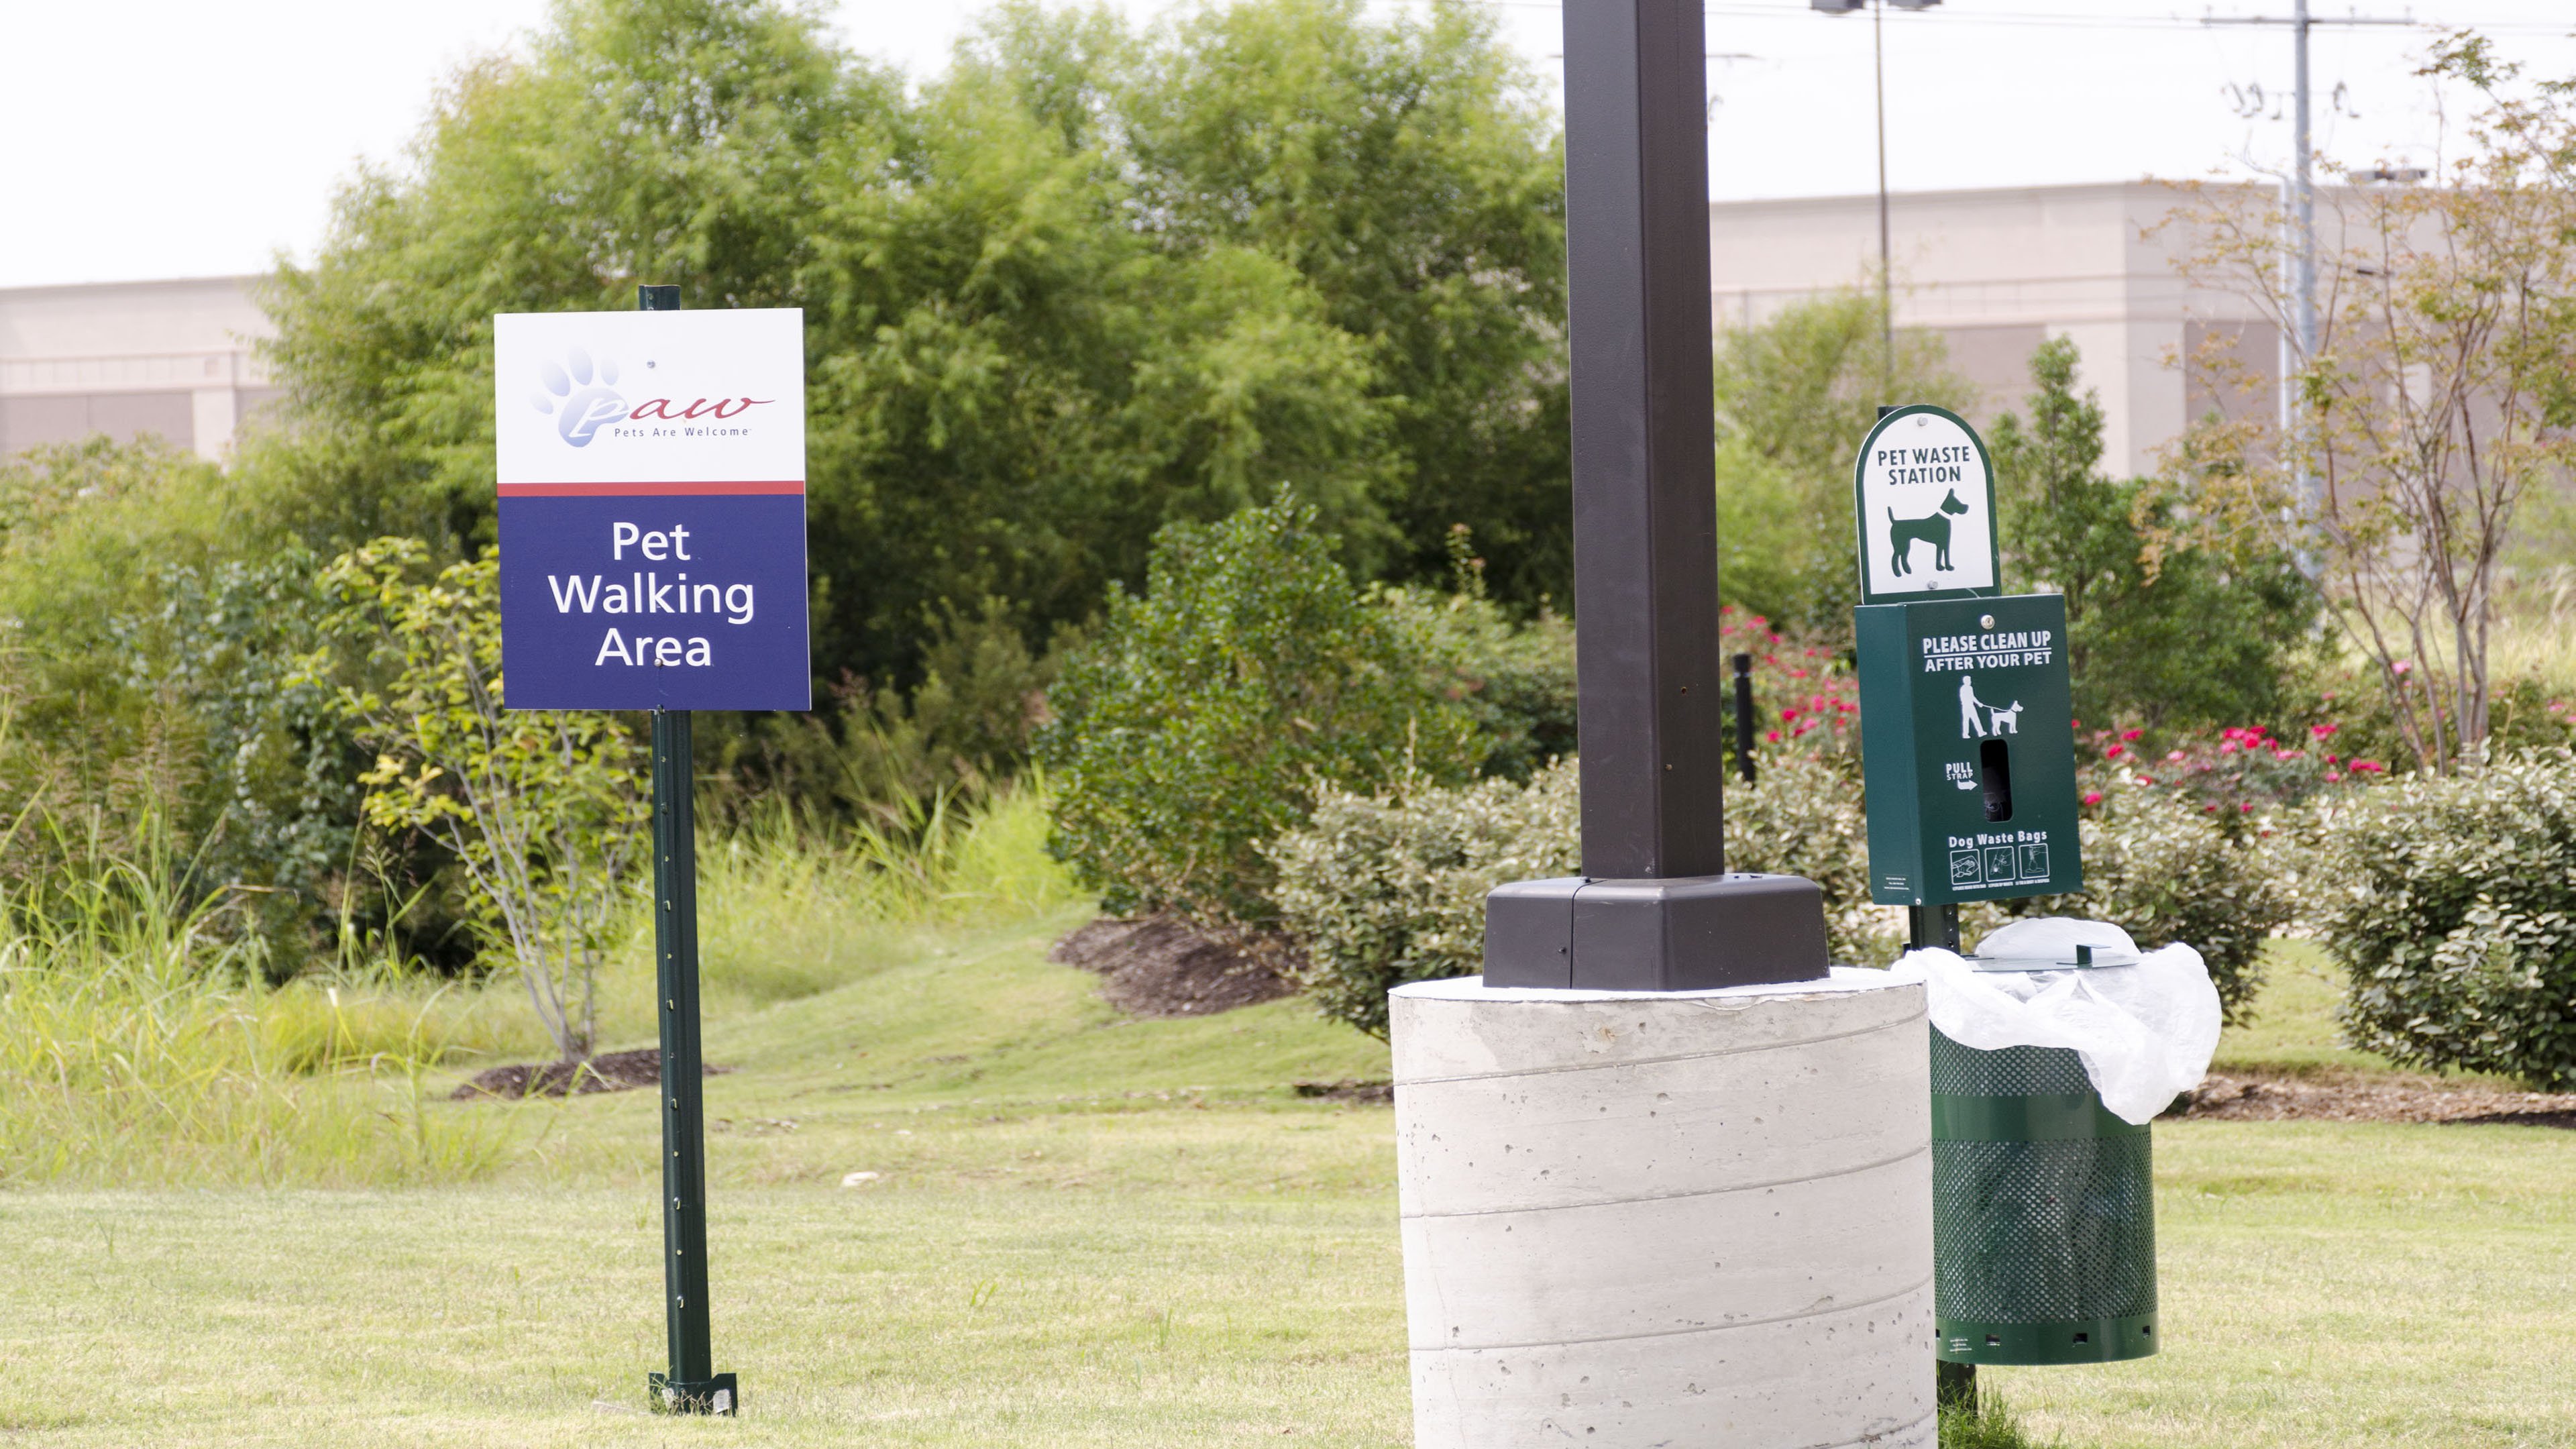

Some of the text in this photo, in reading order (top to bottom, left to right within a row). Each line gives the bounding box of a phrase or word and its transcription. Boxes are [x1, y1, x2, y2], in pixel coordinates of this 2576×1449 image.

[614, 427, 749, 437] Pets Are Welcome
[1878, 446, 1970, 466] PET WASTE
[1888, 466, 1961, 485] STATION
[612, 522, 690, 561] Pet
[547, 572, 754, 625] Walking
[595, 627, 712, 666] Area
[1923, 630, 2051, 654] PLEASE CLEAN UP
[1925, 651, 2052, 673] AFTER YOUR PET
[1945, 761, 1974, 774] PULL
[1946, 772, 1974, 781] STRAP
[1948, 830, 2047, 849] Dog Waste Bags
